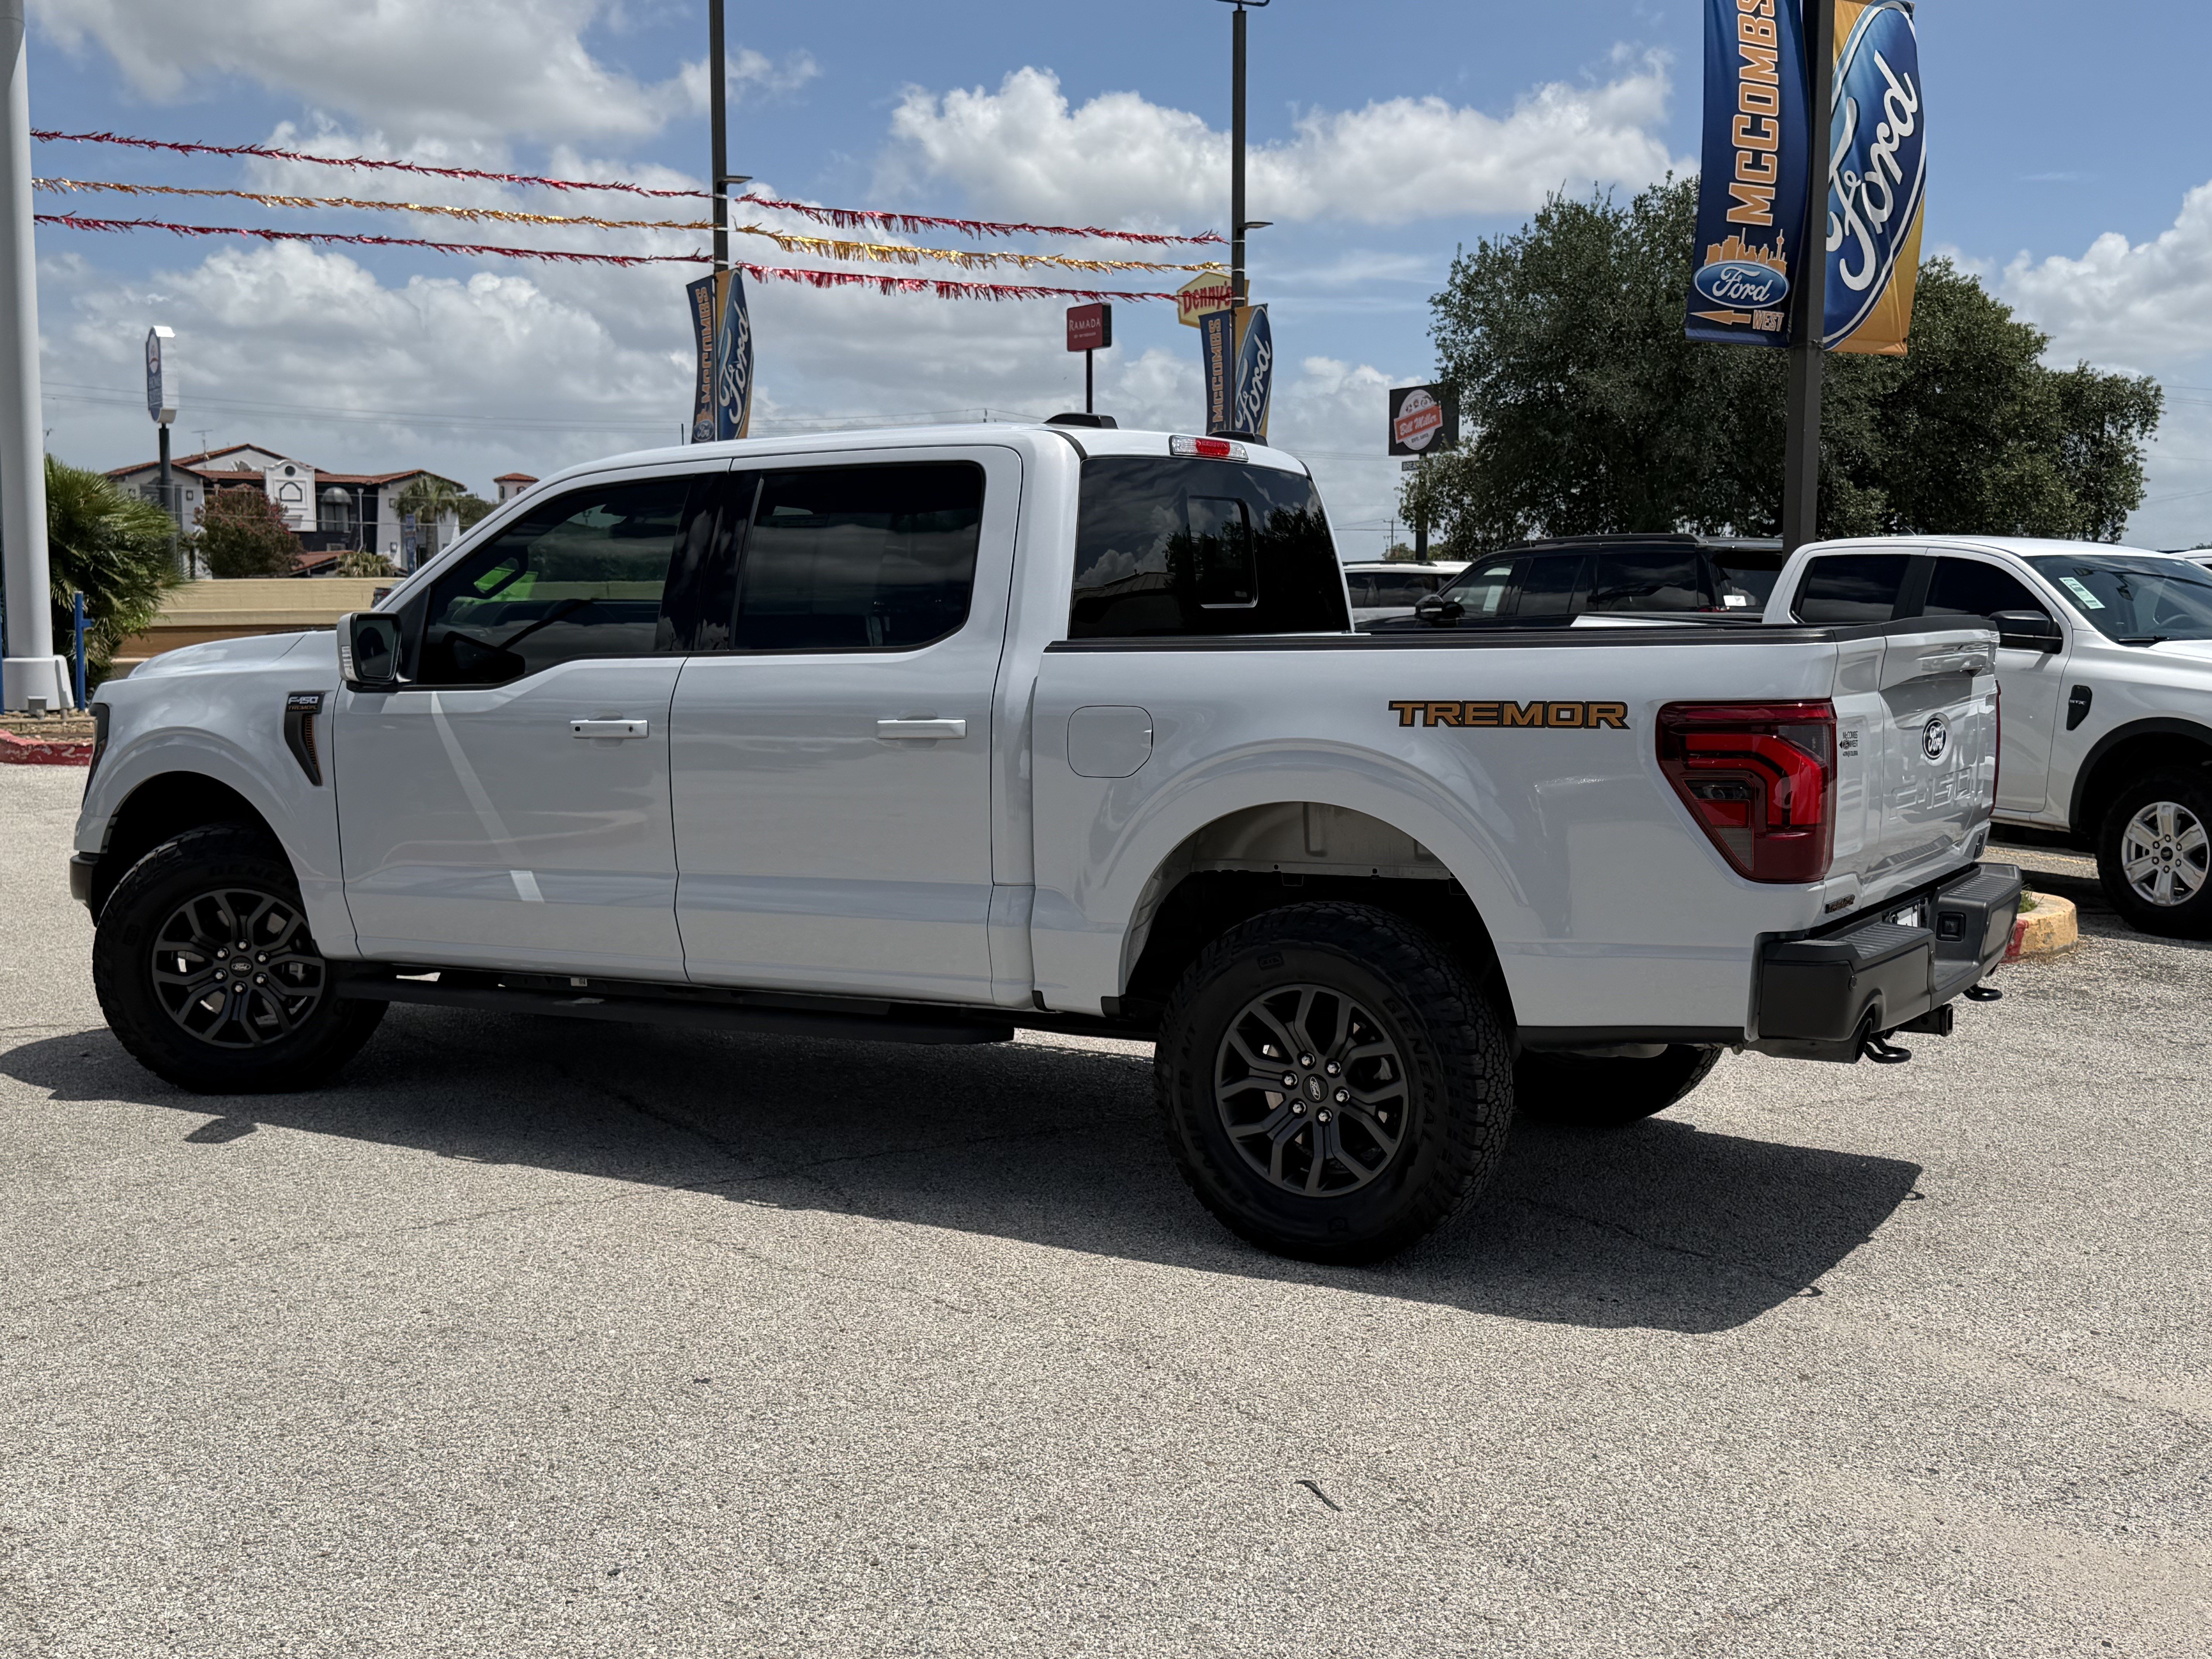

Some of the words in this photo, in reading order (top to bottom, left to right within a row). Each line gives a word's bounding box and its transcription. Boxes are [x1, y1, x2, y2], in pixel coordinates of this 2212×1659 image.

[1826, 50, 1918, 291] Ford
[1712, 266, 1772, 302] Ford
[1069, 318, 1101, 331] RAMADA
[1752, 310, 1784, 333] WEST
[719, 300, 749, 424] Ford
[1208, 318, 1223, 422] MCCOMBS
[1235, 333, 1271, 433] Ford
[1388, 701, 1631, 730] TREMOR
[1928, 724, 1945, 752] Ford
[1383, 997, 1436, 1146] GENERAL
